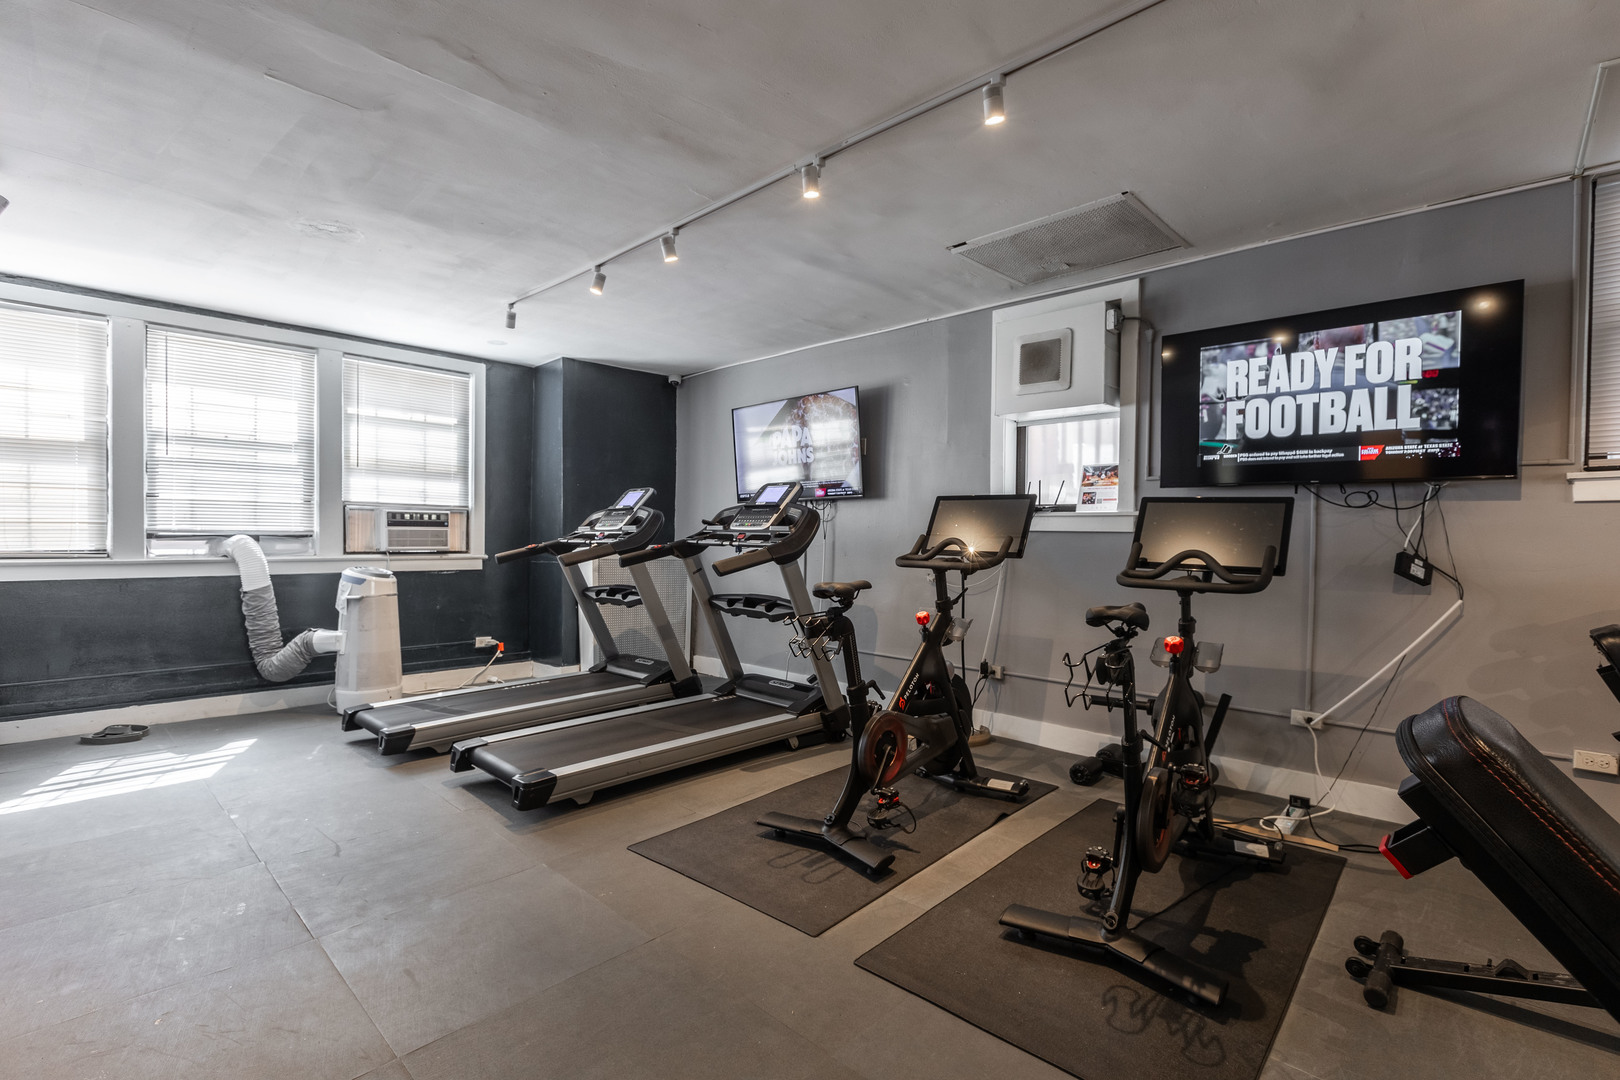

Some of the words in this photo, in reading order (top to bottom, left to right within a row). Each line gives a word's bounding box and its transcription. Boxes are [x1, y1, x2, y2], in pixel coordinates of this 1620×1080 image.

[1226, 347, 1339, 398] READY
[1344, 337, 1423, 386] FOR
[1226, 384, 1421, 440] FOOTBALL
[772, 425, 813, 448] PAPA
[774, 446, 815, 465] JOHNS
[903, 672, 920, 700] PELOTON
